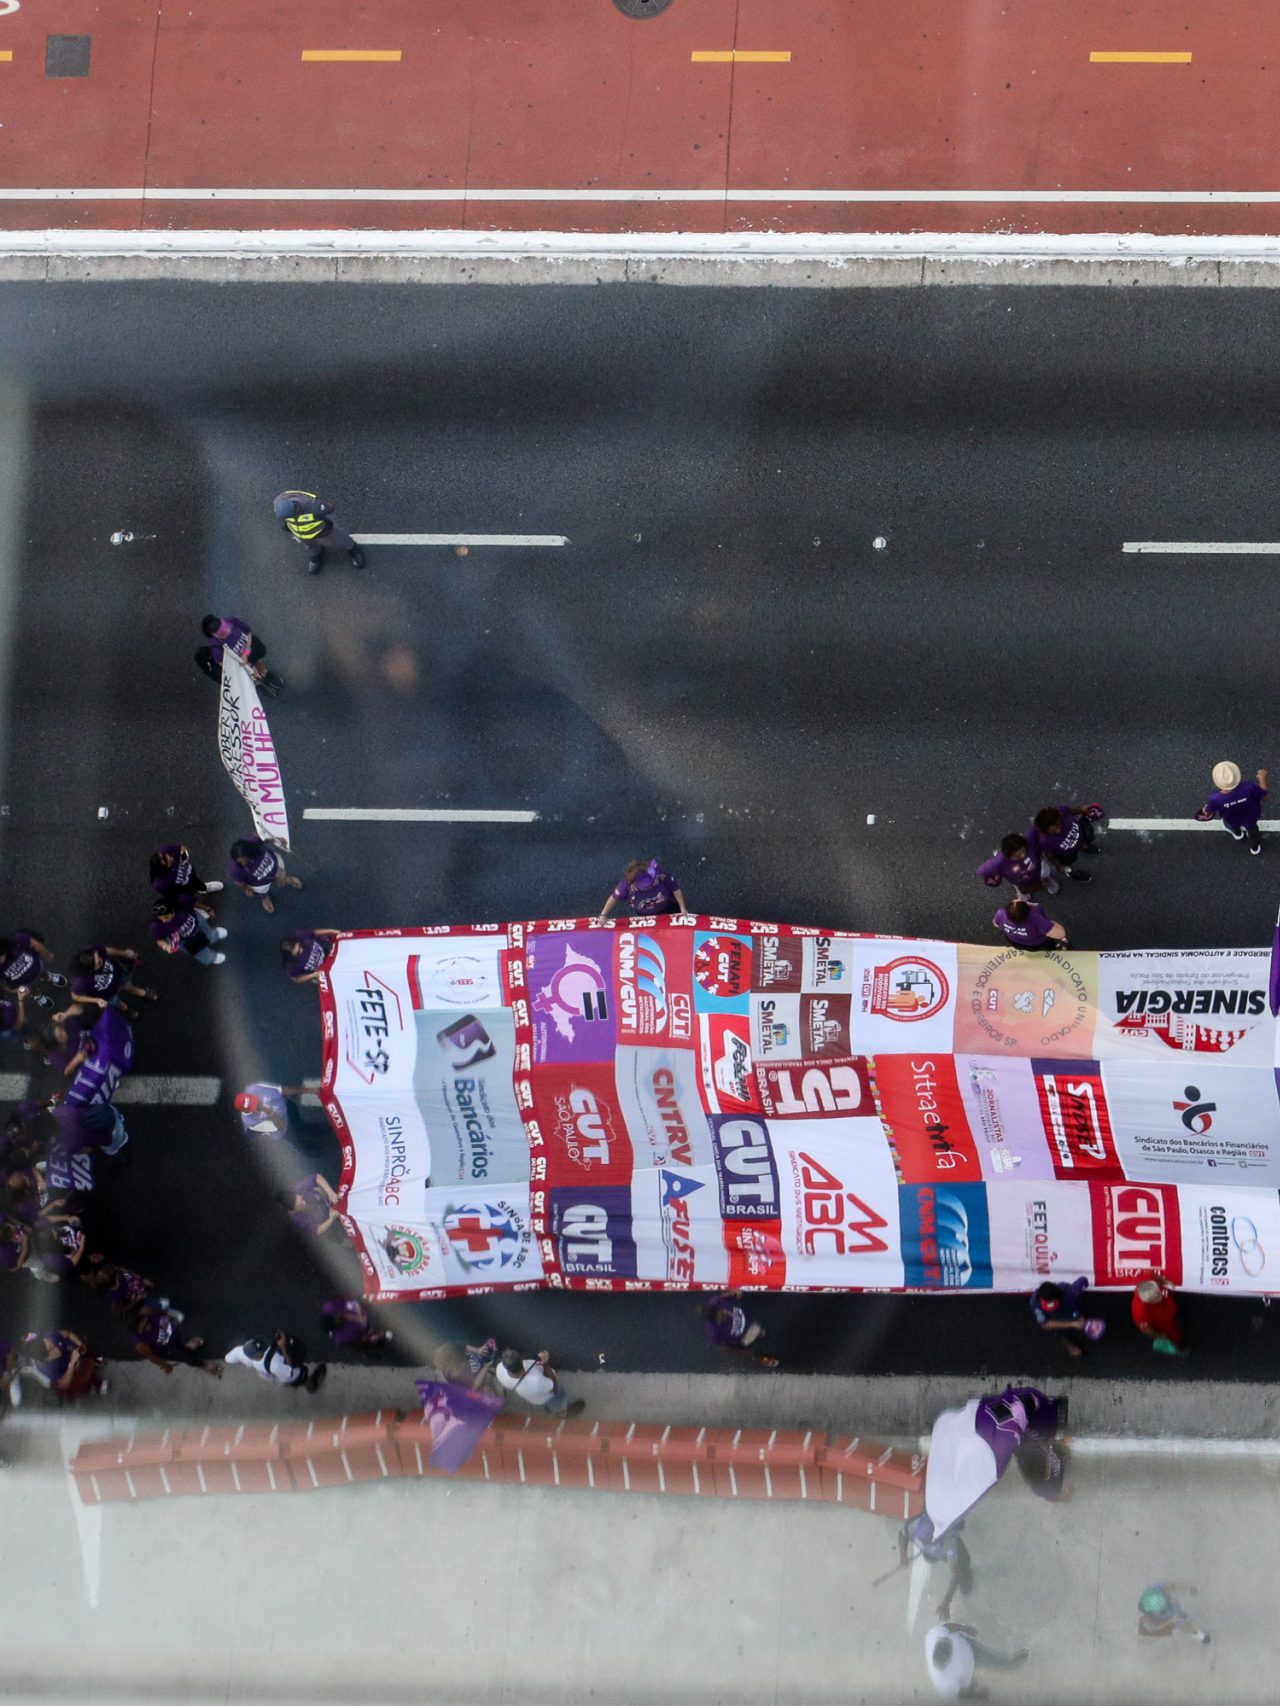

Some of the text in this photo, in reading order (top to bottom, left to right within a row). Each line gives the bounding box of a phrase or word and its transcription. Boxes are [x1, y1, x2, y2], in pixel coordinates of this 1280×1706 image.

[241, 720, 258, 793] APOIAR
[252, 706, 286, 825] A MULHER
[710, 920, 737, 931] CUT
[513, 960, 523, 987] CUT
[619, 932, 637, 1030] CNM/CUT
[717, 952, 730, 983] CUT
[729, 942, 742, 994] FENAPI
[763, 936, 779, 987] SMETAL
[815, 936, 831, 987] SMETAL
[1044, 949, 1088, 1003] SINDICATO
[517, 999, 530, 1027] CUT
[674, 995, 691, 1036] CUT
[976, 949, 1025, 989] SAPATEIROS
[1004, 1037, 1018, 1048] SP
[989, 990, 998, 1011] CUT
[1115, 989, 1266, 1015] SINERGIA
[761, 1000, 776, 1054] SMETAL
[812, 999, 829, 1053] SMETAL
[1119, 1028, 1148, 1037] CUT
[776, 1066, 861, 1115] CUT
[986, 1088, 1004, 1143] JORNALISTAS
[454, 1079, 494, 1179] Bancários
[487, 1115, 497, 1129] dos
[528, 1120, 544, 1147] CUT
[555, 1096, 580, 1162] SÃO PAULO
[569, 1088, 610, 1165] CUT
[653, 1068, 693, 1166] CNTRV
[1134, 1135, 1168, 1145] Sindicato
[1169, 1138, 1182, 1146] dos
[1183, 1139, 1219, 1148] Bancários
[1225, 1141, 1268, 1150] Financiários
[536, 1157, 546, 1180] CUT
[719, 1120, 775, 1204] CUT
[1167, 1146, 1188, 1154] Paulo,
[1189, 1147, 1214, 1155] Osasco
[1222, 1149, 1247, 1157] Região
[662, 1169, 705, 1282] AFUSE
[726, 1204, 778, 1214] BRASIL
[799, 1151, 845, 1256] ABC
[1116, 1188, 1163, 1268] CUT
[513, 1247, 529, 1269] ABC
[562, 1204, 613, 1262] CUT
[1210, 1206, 1229, 1276] contracs
[566, 1263, 616, 1273] BRASIL
